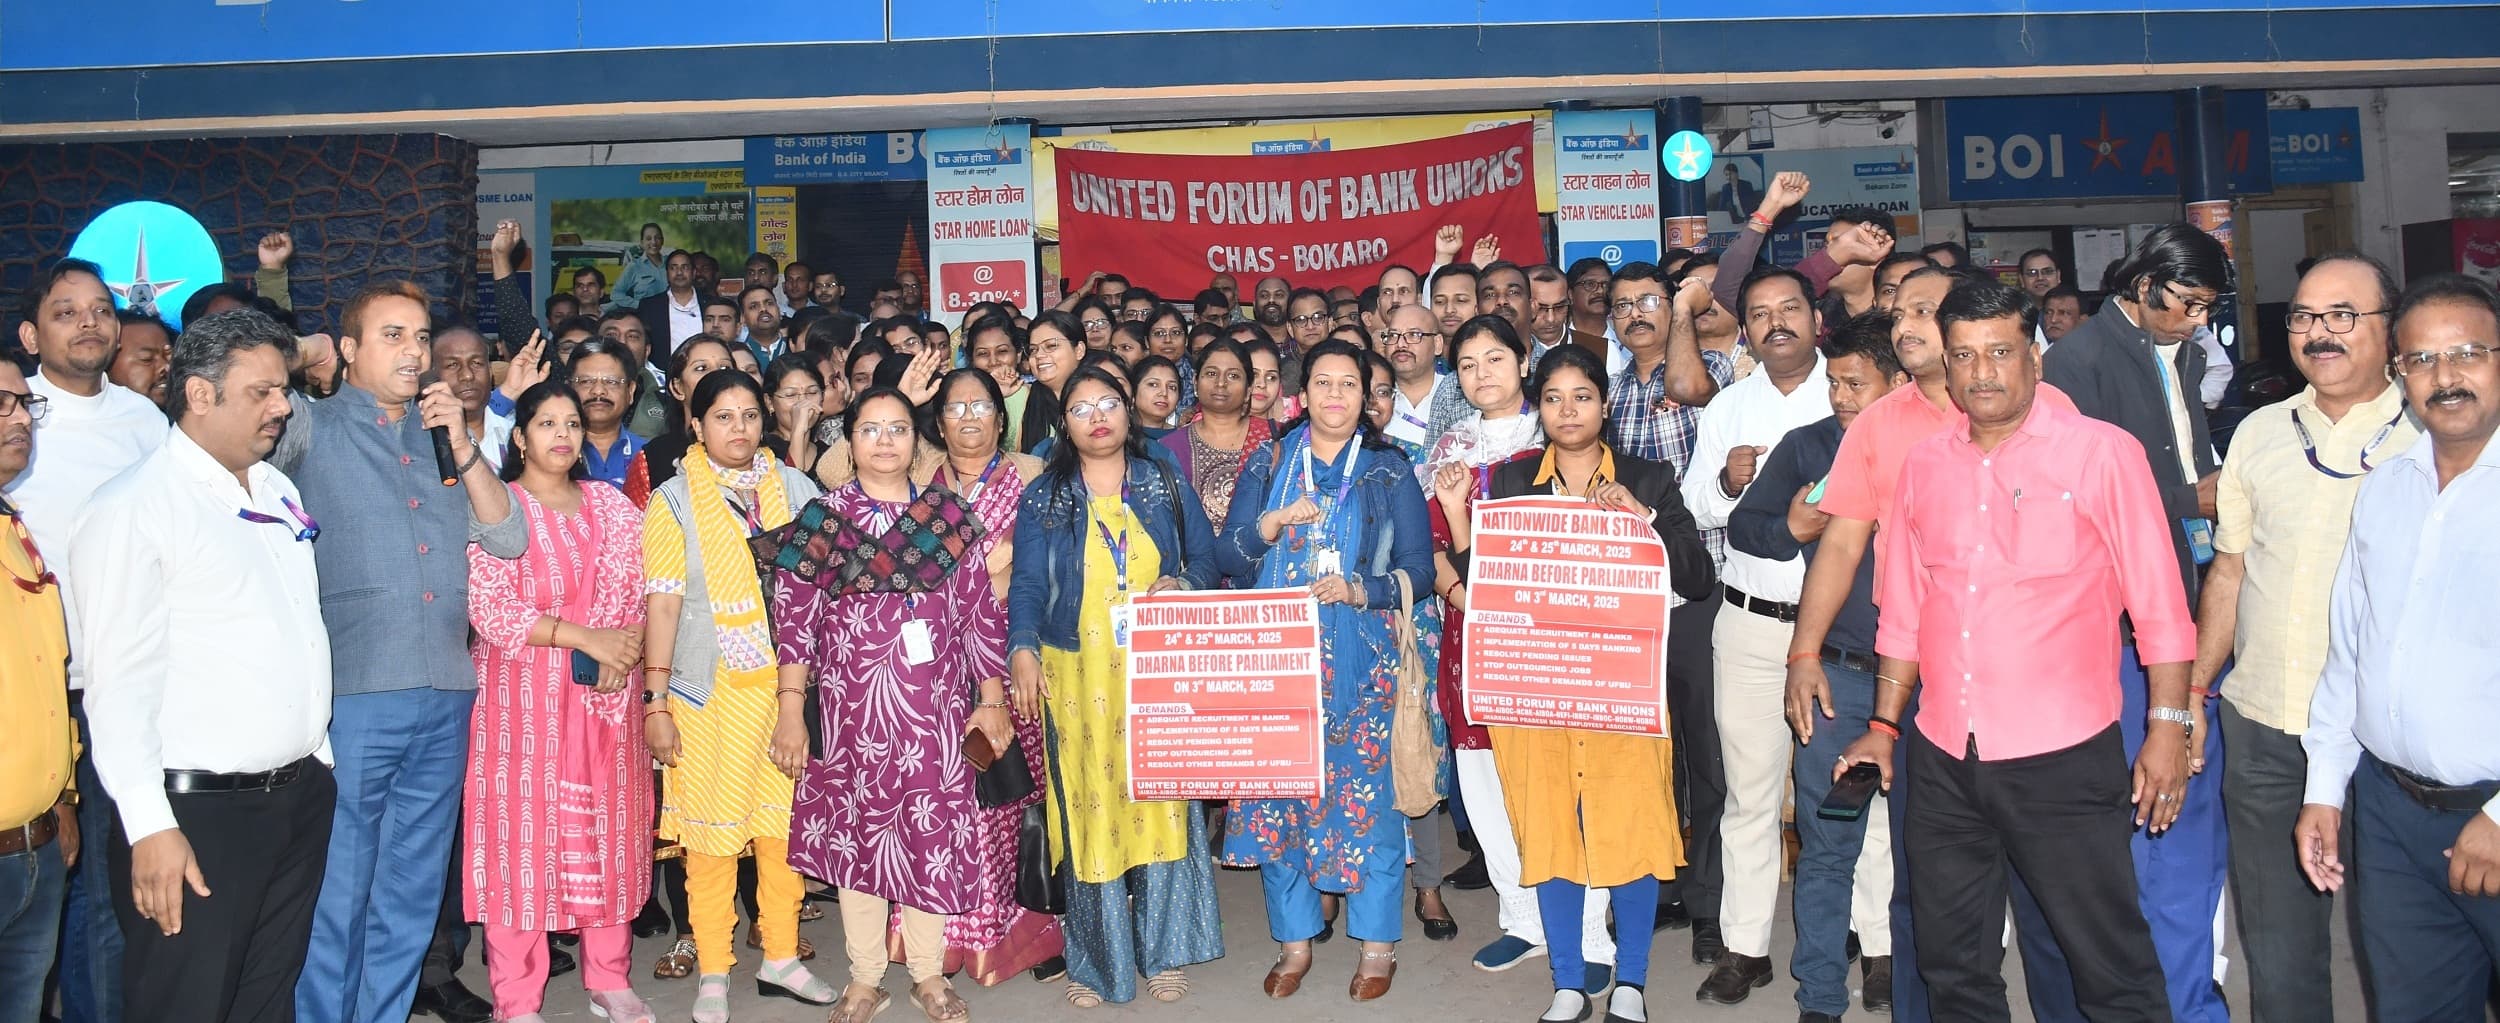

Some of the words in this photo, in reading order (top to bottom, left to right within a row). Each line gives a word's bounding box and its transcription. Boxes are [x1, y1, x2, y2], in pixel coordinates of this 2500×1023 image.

[1566, 138, 1578, 148] बैंक
[2288, 133, 2330, 153] BOI
[774, 153, 810, 165] Bank
[814, 153, 828, 164] of
[832, 152, 866, 164] India
[938, 154, 950, 164] बैंक
[1964, 134, 2064, 180] BOI
[1071, 169, 1176, 223] UNITED
[1188, 180, 1293, 225] FORUM
[1299, 177, 1332, 222] OF
[1339, 168, 1421, 218] BANK
[1426, 145, 1523, 206] UNIONS
[1563, 175, 1588, 190] स्टार
[1591, 174, 1622, 190] वाहन
[1626, 170, 1650, 190] लोन
[504, 193, 534, 202] LOAN
[935, 190, 964, 206] स्टार
[967, 186, 992, 206] होम
[996, 184, 1024, 204] लोन
[1561, 205, 1585, 220] STAR
[1587, 204, 1627, 220] VEHICLE
[1631, 203, 1654, 219] LOAN
[760, 218, 788, 228] गोल्ड
[935, 222, 962, 239] STAR
[966, 220, 996, 238] HOME
[1000, 218, 1028, 237] LOAN
[762, 231, 786, 240] लोन
[1207, 244, 1275, 272] CHAS
[1293, 237, 1388, 271] BOKARO
[1601, 245, 1622, 266] @
[974, 266, 993, 285] @
[1481, 512, 1568, 533] NATIONWIDE
[1572, 515, 1608, 535] BANK
[1613, 517, 1656, 540] STRIKE
[1530, 542, 1538, 553] &
[1560, 543, 1602, 559] MARCH,
[1606, 546, 1631, 559] 2025
[1479, 561, 1528, 582] DHARNA
[1532, 563, 1577, 584] BEFORE
[1581, 566, 1661, 590] PARLIAMENT
[1515, 590, 1530, 603] ON
[1549, 594, 1591, 608] MARCH,
[1594, 596, 1620, 609] 2025
[1137, 606, 1219, 626] NATIONWIDE
[1224, 605, 1258, 625] BANK
[1263, 603, 1309, 623] STRIKE
[1477, 613, 1527, 624] DEMANDS
[1185, 634, 1192, 644] &
[1215, 633, 1254, 646] MARCH,
[1258, 632, 1282, 644] 2025
[1530, 629, 1589, 639] RECRUITMENT
[1603, 632, 1632, 641] BANKS
[1483, 638, 1556, 648] IMPLEMENTATION
[1602, 645, 1641, 653] BANKING
[1136, 655, 1185, 674] DHARNA
[1189, 654, 1232, 673] BEFORE
[1236, 652, 1310, 671] PARLIAMENT
[1483, 650, 1520, 658] RESOLVE
[1522, 652, 1559, 661] PENDING
[1562, 654, 1592, 662] ISSUES
[1507, 663, 1567, 673] OUTSOURCING
[1174, 682, 1189, 694] ON
[1207, 681, 1247, 694] MARCH,
[1250, 680, 1274, 692] 2025
[1483, 673, 1520, 681] RESOLVE
[1522, 675, 1549, 683] OTHER
[1552, 677, 1593, 686] DEMANDS
[1139, 705, 1187, 714] DEMANDS
[1472, 694, 1512, 706] UNITED
[1516, 697, 1556, 708] FORUM
[1559, 700, 1573, 710] OF
[1576, 702, 1608, 713] BANK
[1611, 704, 1655, 716] UNIONS
